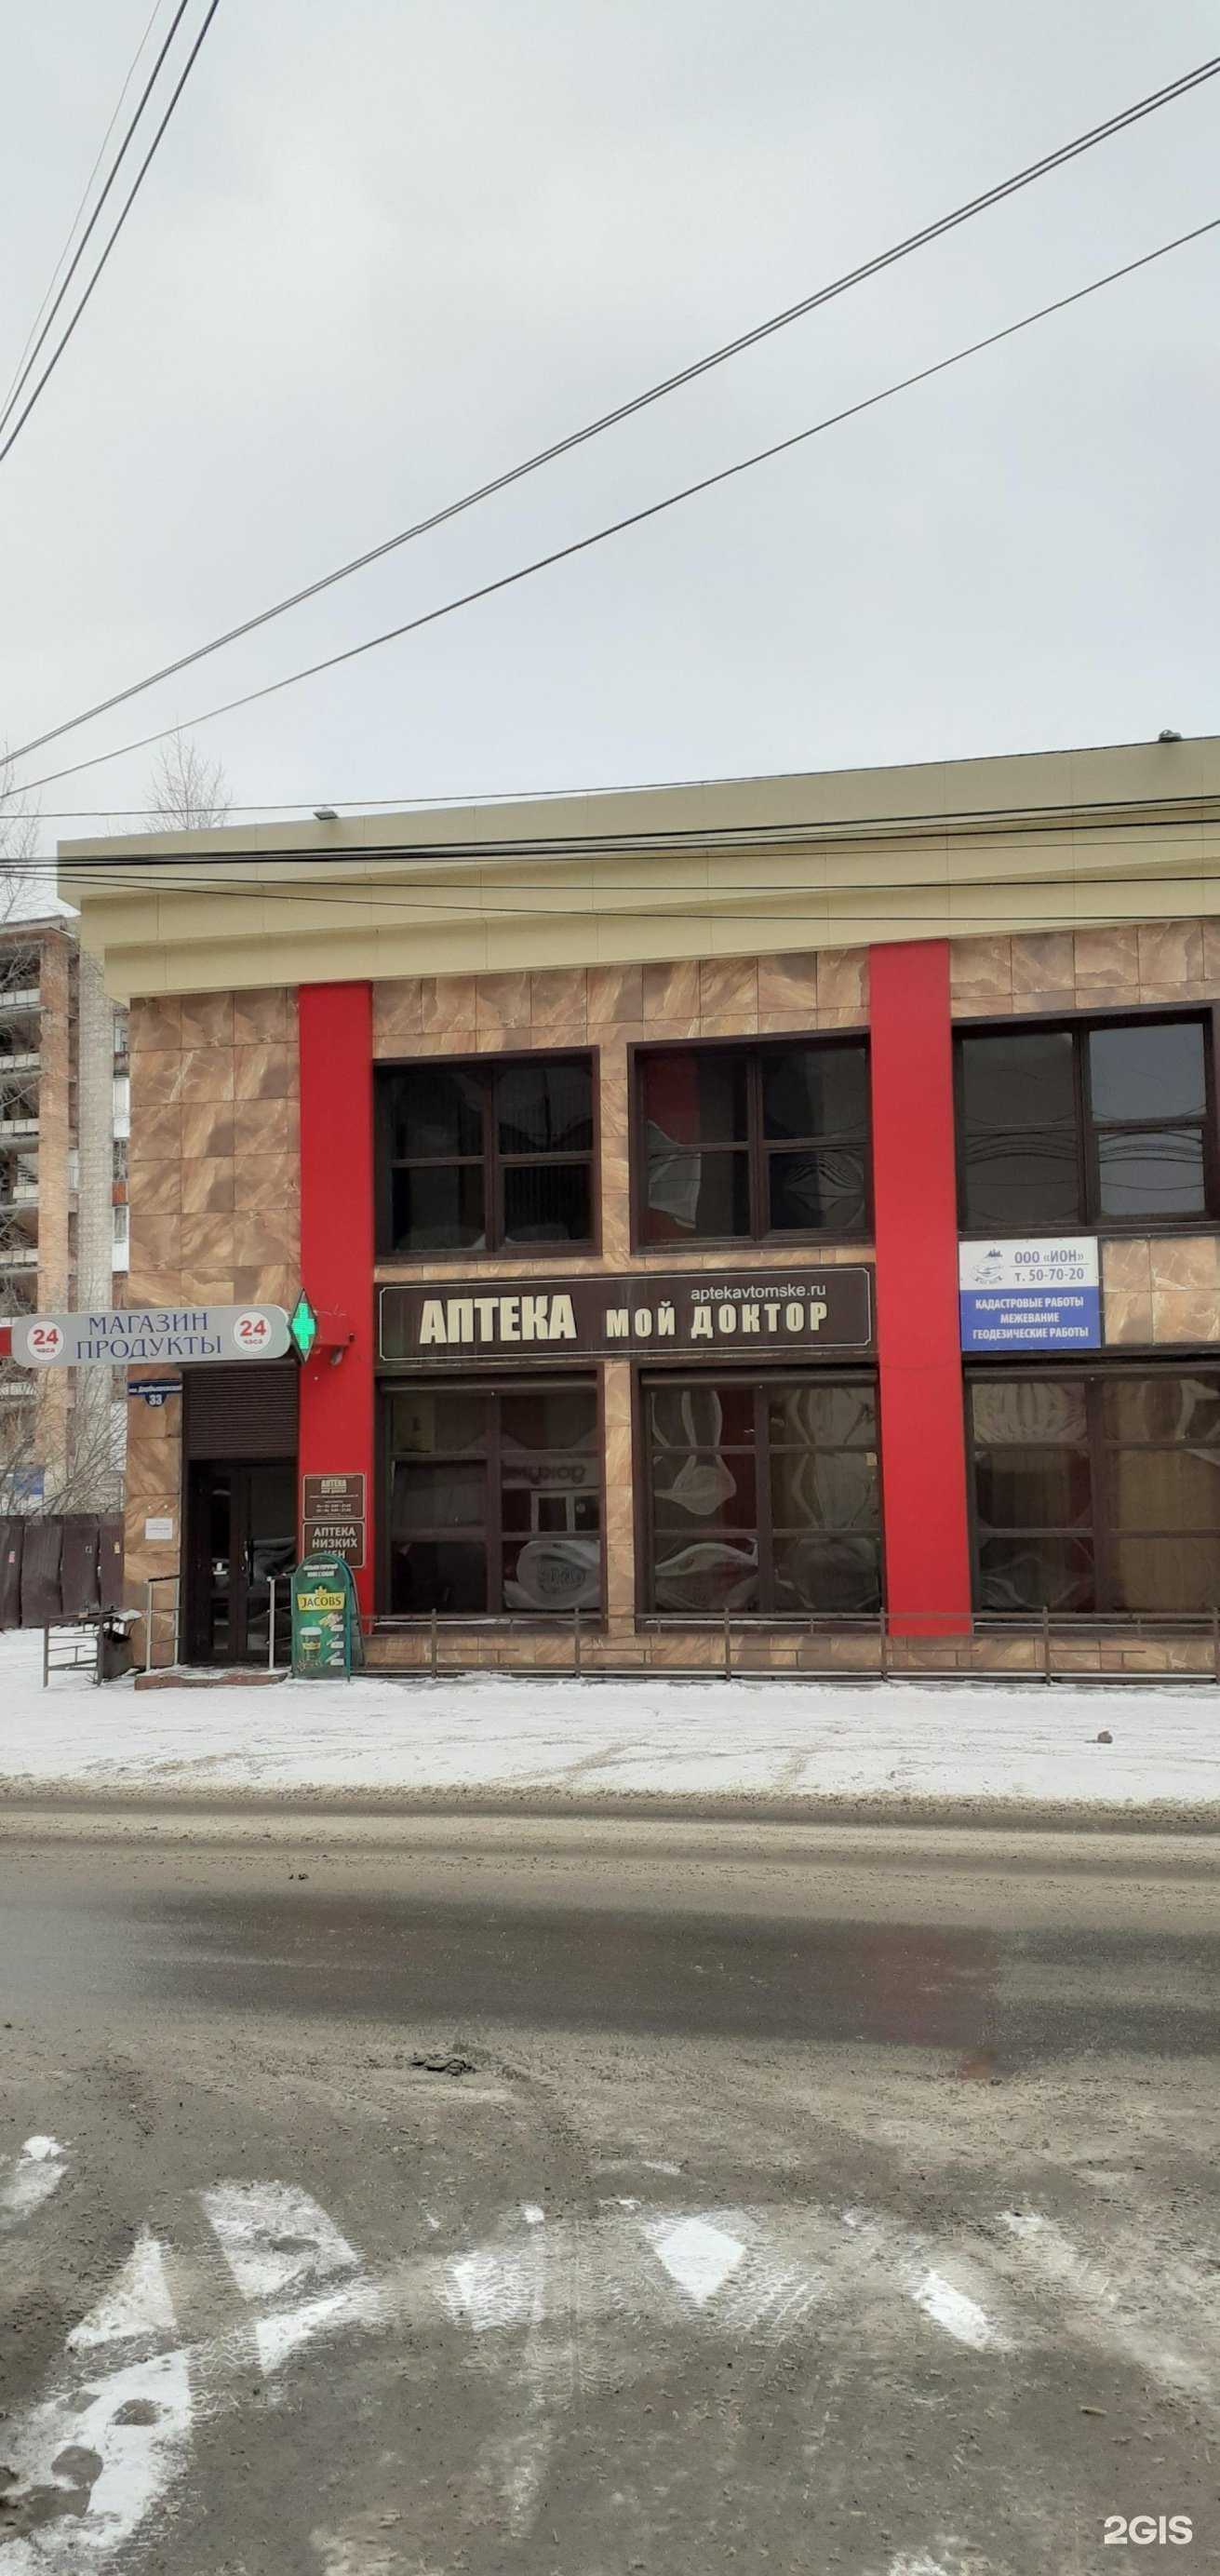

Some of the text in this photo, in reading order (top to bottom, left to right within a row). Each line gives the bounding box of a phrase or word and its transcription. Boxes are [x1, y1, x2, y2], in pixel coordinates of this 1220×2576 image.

[1014, 1249, 1084, 1264] ООО «ИОН»
[1028, 1268, 1084, 1281] 50-70-20
[690, 1283, 826, 1303] aptekavtomske.ru
[975, 1296, 1084, 1310] КАДАСТРОВЫЕ РАБОТЫ
[88, 1312, 208, 1335] МАГАЗИН
[419, 1294, 577, 1345] АПТЕКА
[606, 1301, 827, 1339] МОЙ ДОКТОР
[1000, 1312, 1060, 1323] МЕЖЕВАНИЕ
[239, 1320, 267, 1337] 24
[972, 1326, 1089, 1340] ГЕОДЕЗИЧЕСКИЕ РАБОТЫ
[33, 1328, 60, 1347] 24
[244, 1337, 263, 1346] часа
[76, 1335, 221, 1360] ПРОДУКТЫ
[149, 1394, 162, 1405] 33
[314, 1526, 355, 1536] АПТЕКА
[312, 1538, 358, 1549] НИЗКИХ
[301, 1596, 342, 1609] JACOBS
